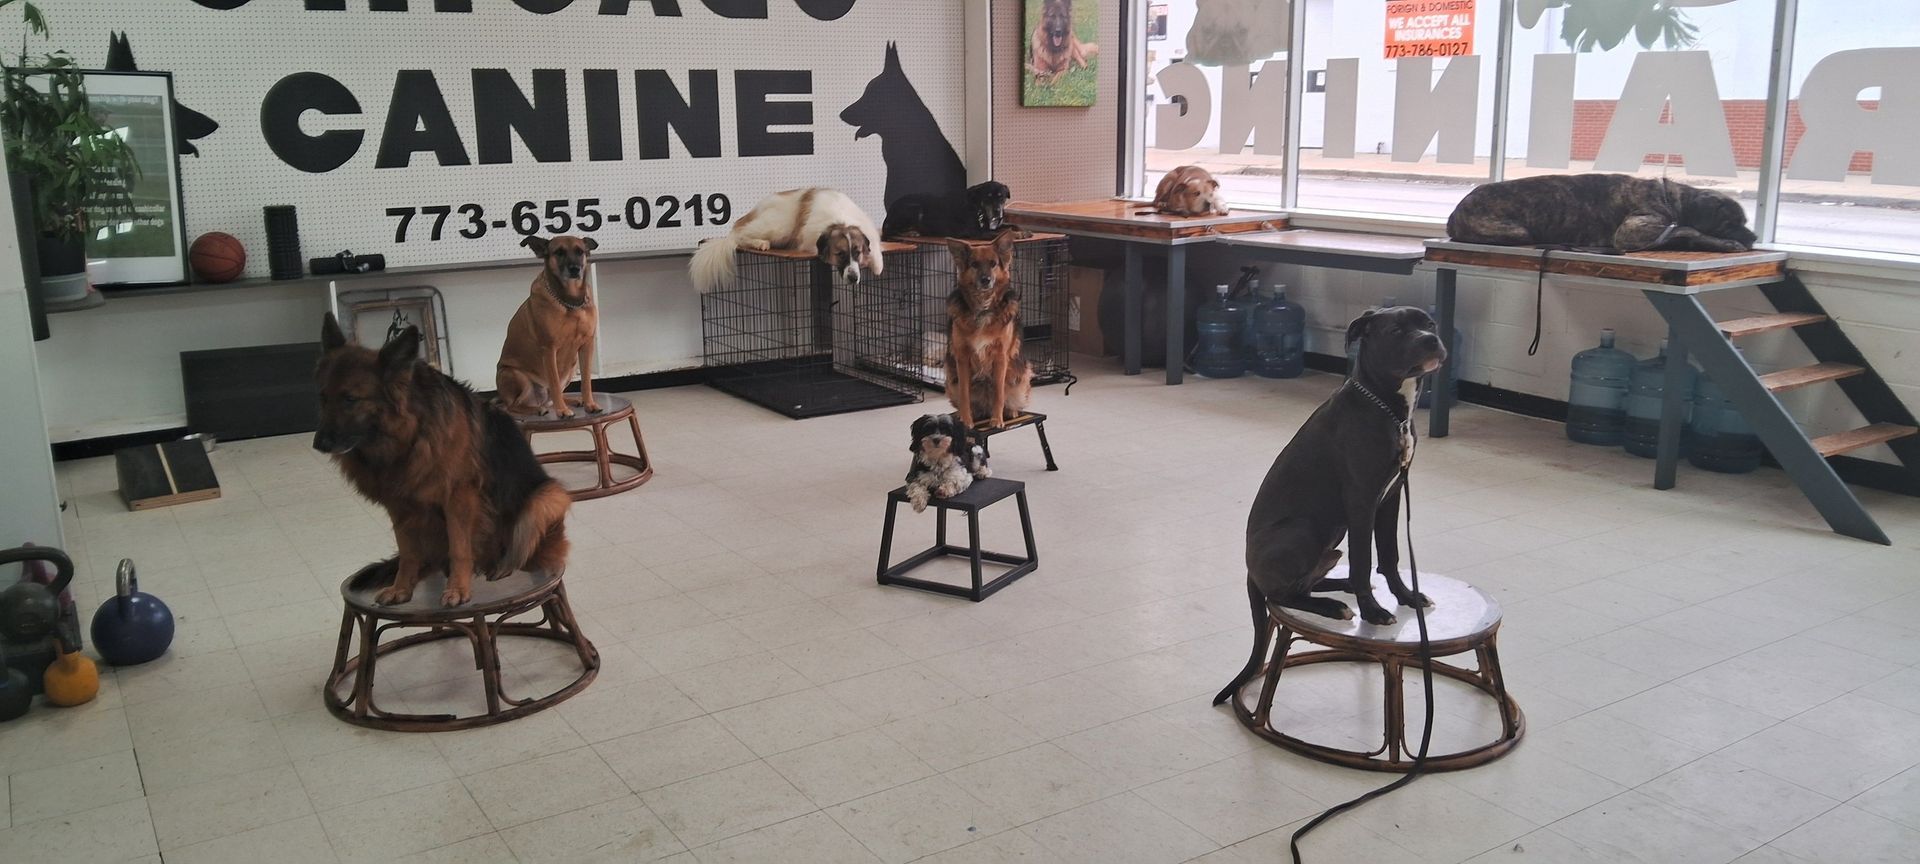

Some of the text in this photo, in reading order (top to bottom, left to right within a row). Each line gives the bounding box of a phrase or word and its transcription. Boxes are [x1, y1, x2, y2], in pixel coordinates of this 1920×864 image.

[1420, 3, 1427, 12] &
[1429, 0, 1473, 12] DOMESTIC
[1388, 13, 1471, 29] WE ACCEPT ALL
[1394, 26, 1463, 41] INSURANCES
[1385, 42, 1469, 58] 773-786-0127
[259, 67, 815, 174] CANINE
[385, 192, 732, 244] 773-655-0219
